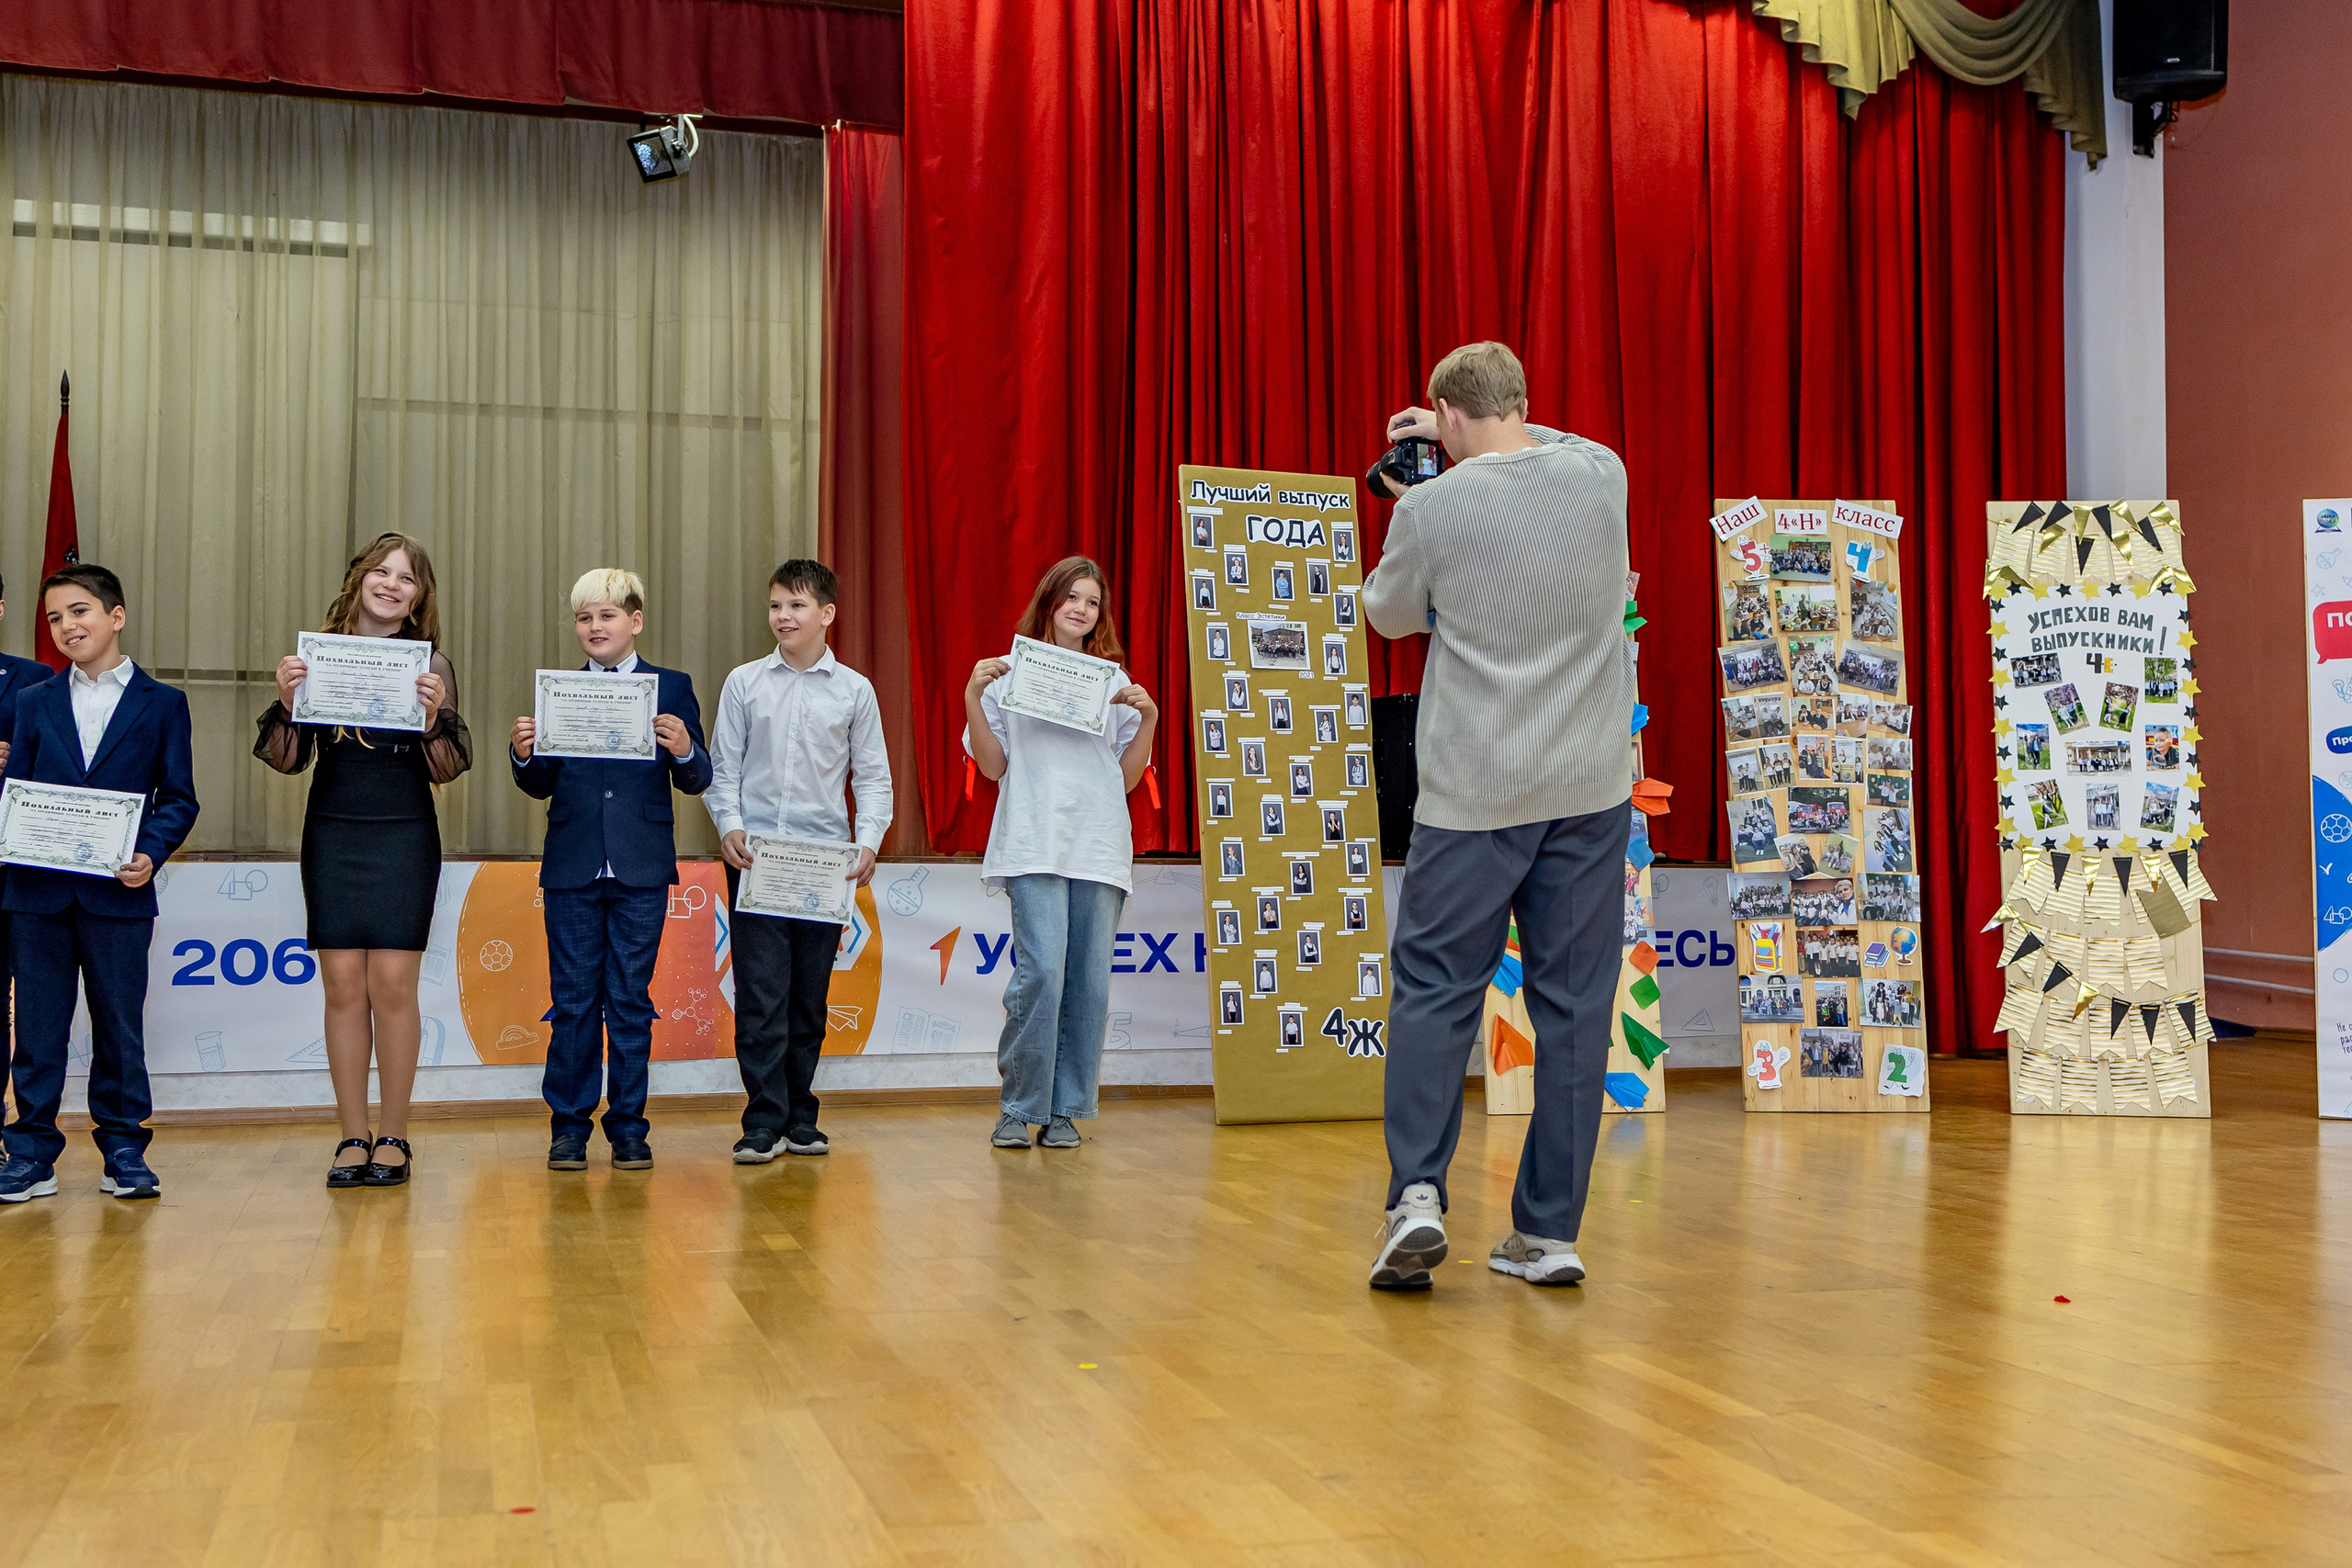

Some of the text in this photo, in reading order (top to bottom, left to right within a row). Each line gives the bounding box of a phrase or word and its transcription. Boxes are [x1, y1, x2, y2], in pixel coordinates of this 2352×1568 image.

[1192, 480, 1349, 512] Лучший выпуск
[1248, 516, 1325, 547] ГОДА
[1714, 504, 1760, 536] Наш
[1836, 506, 1895, 533] класс
[2027, 606, 2154, 634] УСПЕХОВ ВАМ
[973, 932, 1180, 975] УЕХ
[1322, 1008, 1385, 1056] 4Ж
